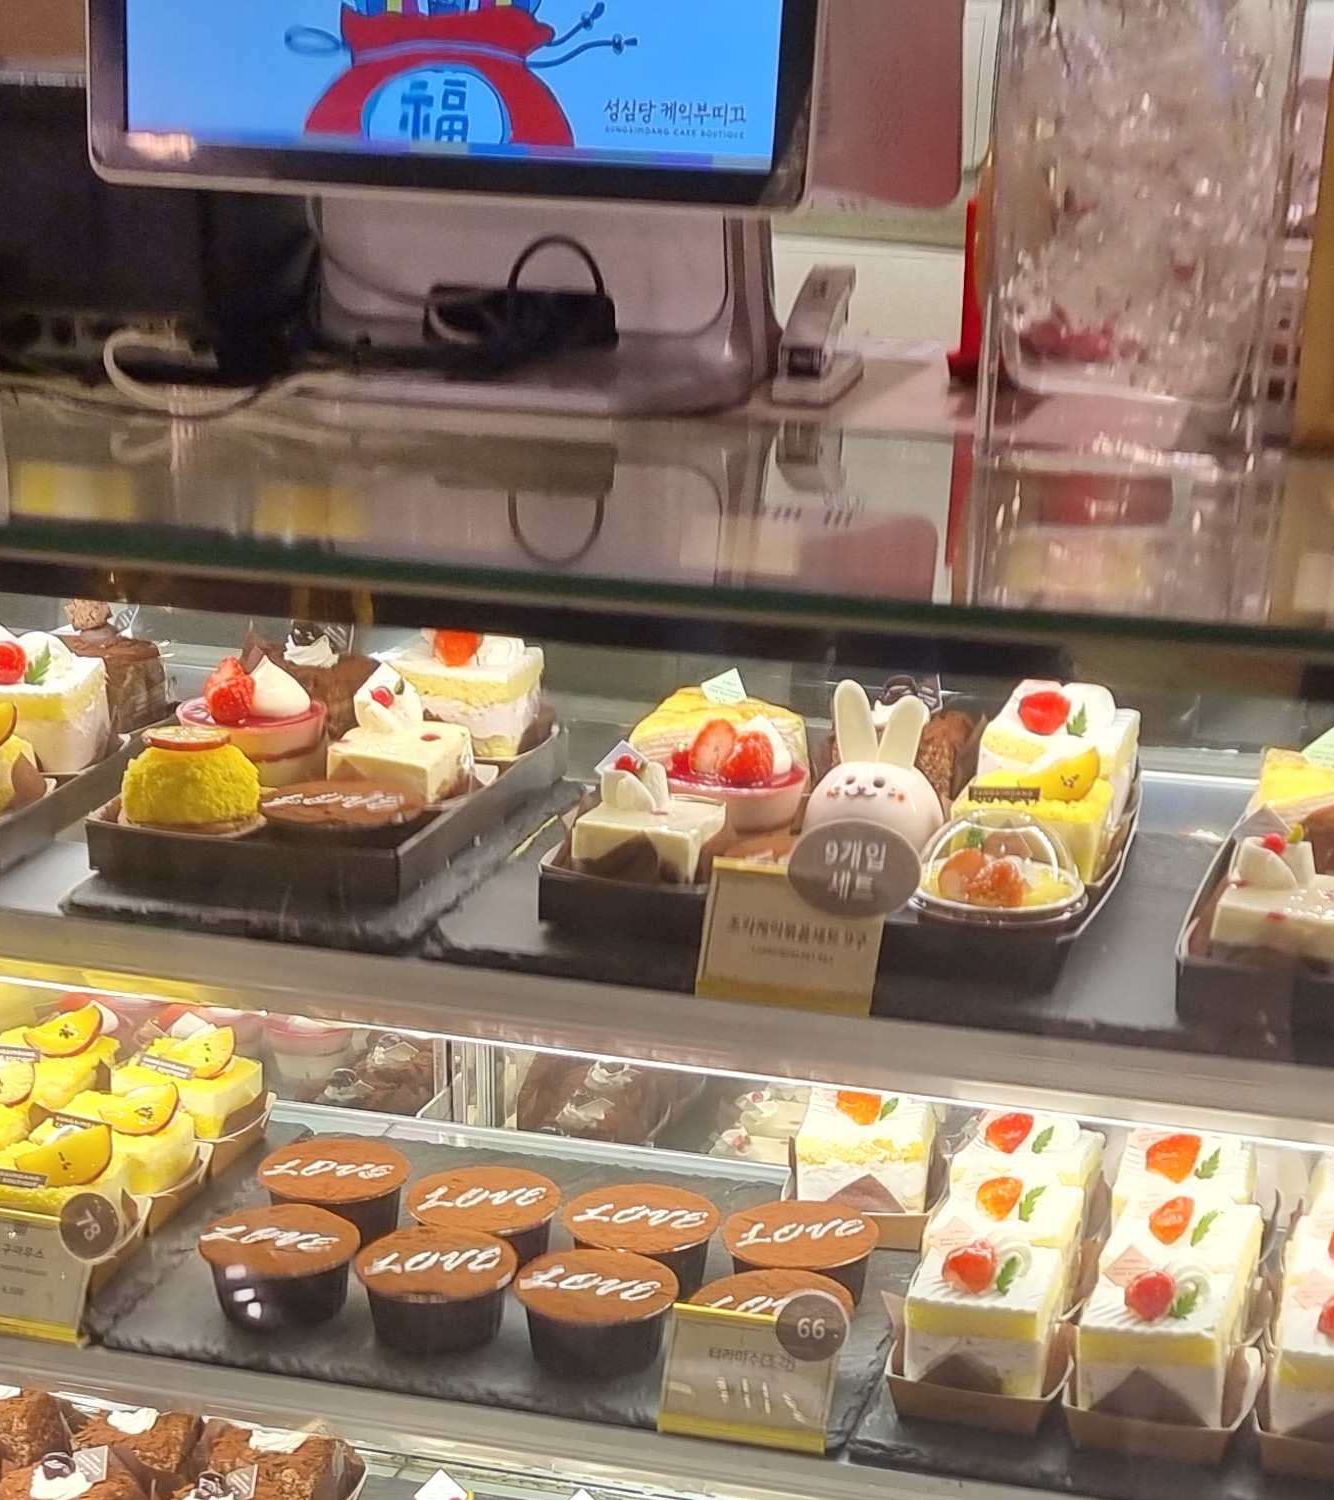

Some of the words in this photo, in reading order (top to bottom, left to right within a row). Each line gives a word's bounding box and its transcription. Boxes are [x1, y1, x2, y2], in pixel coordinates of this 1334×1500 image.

[604, 97, 656, 123] 성심당
[824, 839, 886, 873] 9개입
[827, 870, 874, 900] 세트
[263, 1159, 396, 1180] LOVE
[417, 1185, 547, 1211] LOVE
[75, 1208, 102, 1242] 78
[573, 1202, 709, 1229] LOVE
[199, 1223, 341, 1252] LOVE
[736, 1218, 865, 1247] LOVE
[364, 1244, 503, 1274] LOVE
[519, 1264, 661, 1301] LOVE
[797, 1317, 826, 1339] 66
